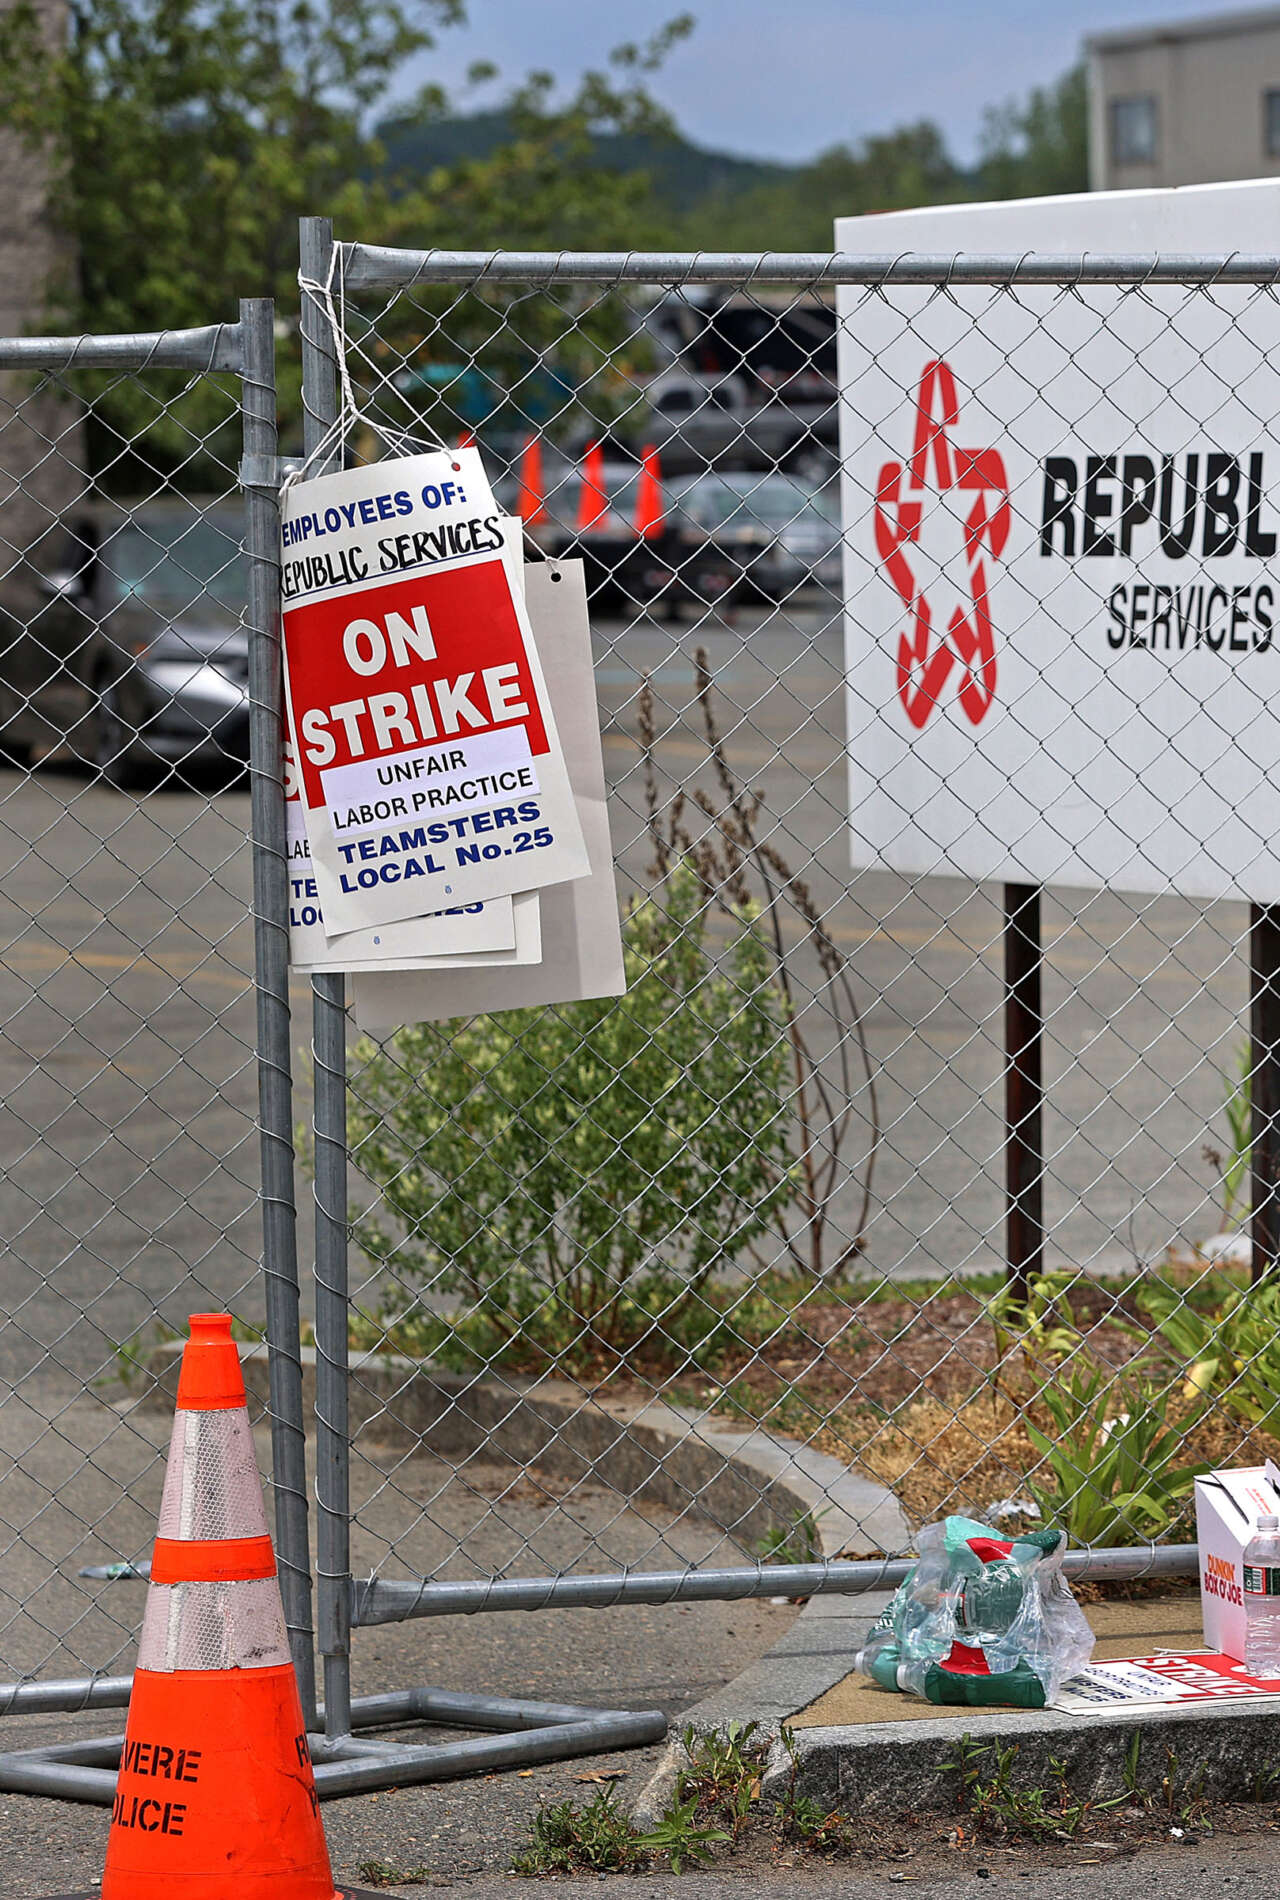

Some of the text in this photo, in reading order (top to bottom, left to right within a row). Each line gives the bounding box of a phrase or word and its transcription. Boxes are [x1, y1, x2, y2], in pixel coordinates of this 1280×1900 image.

[282, 481, 467, 547] EMPLOYEES OF:
[377, 516, 505, 571] SERVICES
[342, 605, 438, 677] ON
[1107, 583, 1274, 652] SERVICES
[301, 662, 530, 767] STRIKE
[333, 767, 534, 830] LABOR PRACTICE
[376, 750, 467, 786] UNFAIR
[337, 801, 541, 864] TEAMSTERS
[339, 854, 446, 894] LOCAL
[455, 826, 555, 867] No.25
[1227, 1583, 1243, 1607] JOE
[1133, 1657, 1269, 1694] STRIKE
